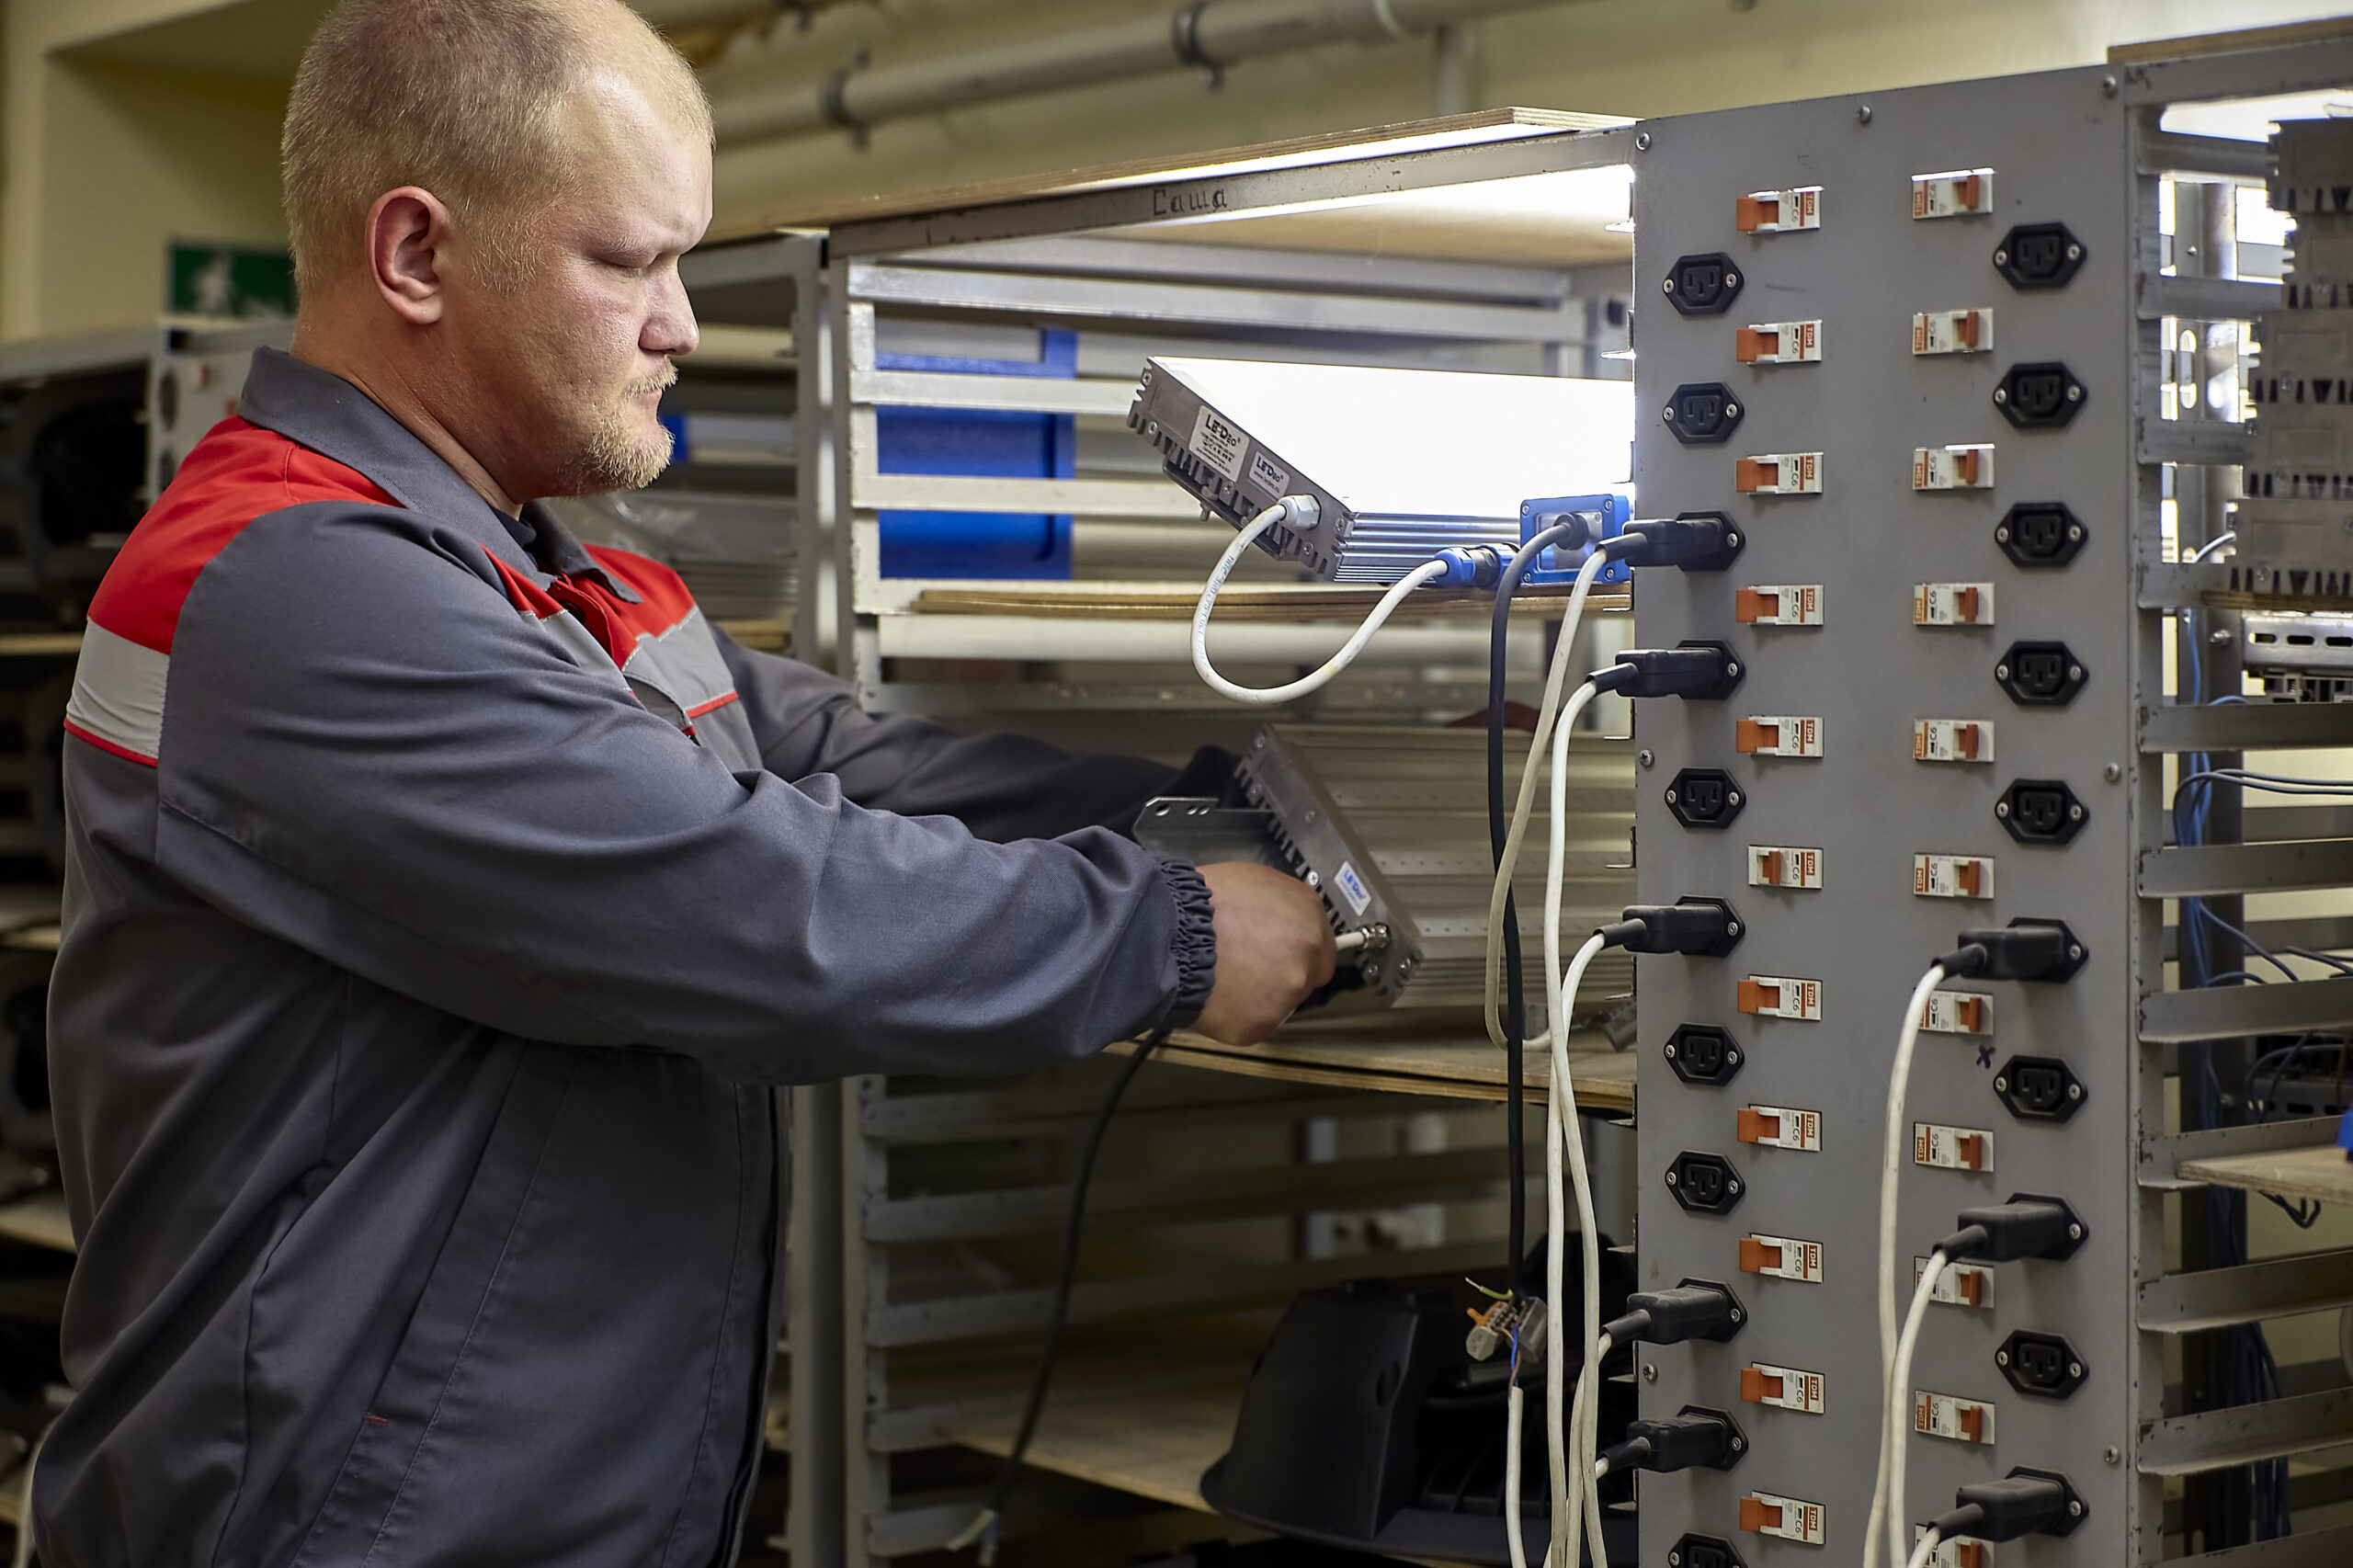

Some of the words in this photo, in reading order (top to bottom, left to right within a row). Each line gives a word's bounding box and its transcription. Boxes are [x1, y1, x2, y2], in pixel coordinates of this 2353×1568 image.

[1154, 188, 1228, 216] Саша
[1791, 209, 1799, 222] C6
[1805, 326, 1814, 347] TDM
[1792, 340, 1799, 354] C6
[1805, 458, 1813, 479] TDM
[1930, 457, 1937, 470] C6
[1791, 472, 1799, 486] C6
[1805, 590, 1814, 611] TDM
[1929, 591, 1937, 605] C6
[1792, 604, 1799, 618] C6
[1806, 722, 1814, 744] TDM
[1930, 727, 1937, 741] C6
[1792, 735, 1799, 748] C6
[1806, 854, 1815, 875] TDM
[1931, 863, 1938, 876] C6
[1792, 866, 1800, 880] C6
[1915, 869, 1924, 891] TDM
[1807, 985, 1815, 1006] TDM
[1793, 997, 1800, 1010] C6
[1931, 998, 1938, 1012] C6
[1806, 1116, 1815, 1138] TDM
[1793, 1128, 1800, 1141] C6
[1932, 1133, 1938, 1147] C6
[1809, 1247, 1817, 1268] TDM
[1795, 1259, 1802, 1272] C6
[1796, 1390, 1803, 1403] C6
[1810, 1379, 1819, 1400] TDM
[1932, 1403, 1939, 1416] C6
[1917, 1406, 1926, 1428] TDM
[1795, 1520, 1802, 1533] C6
[1809, 1509, 1818, 1530] TDM
